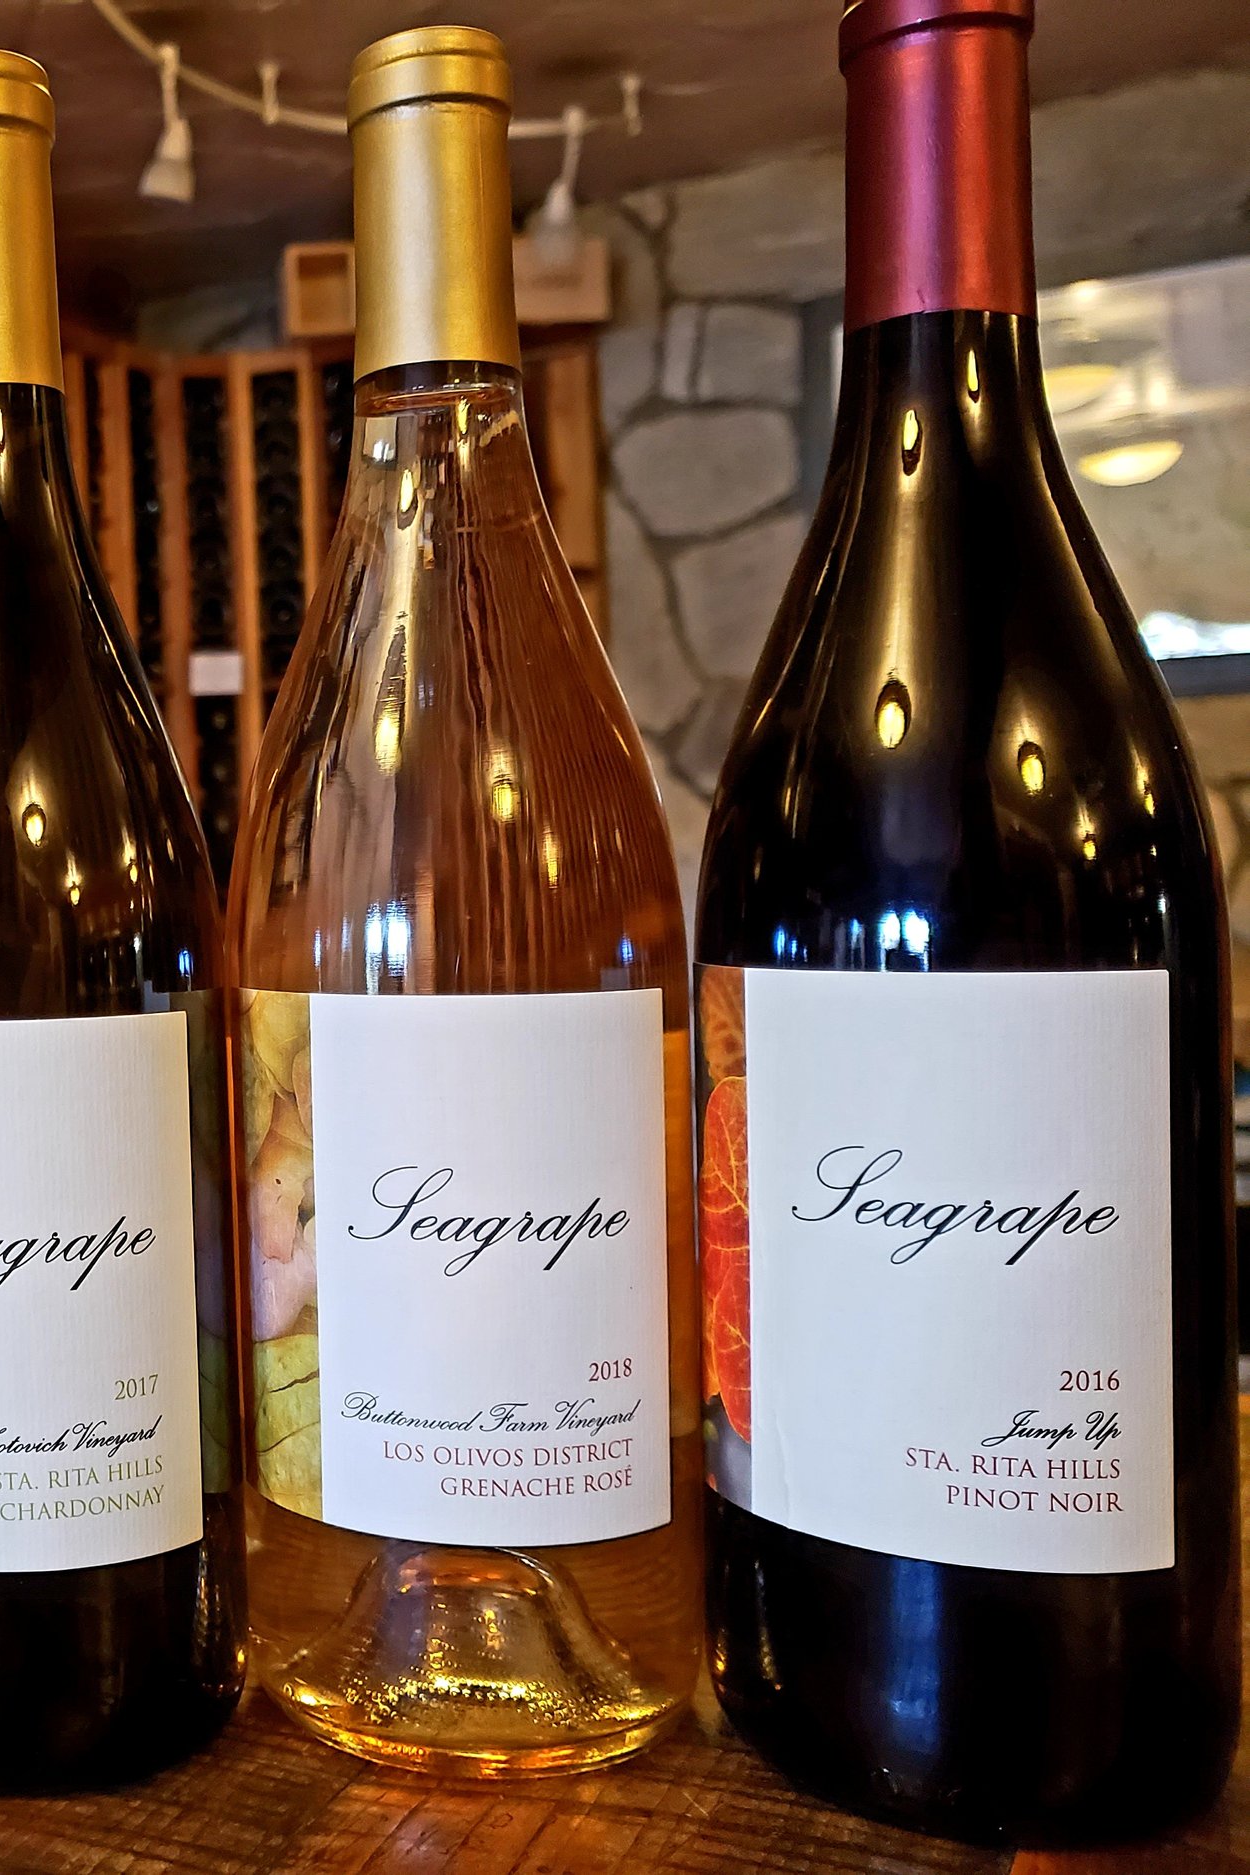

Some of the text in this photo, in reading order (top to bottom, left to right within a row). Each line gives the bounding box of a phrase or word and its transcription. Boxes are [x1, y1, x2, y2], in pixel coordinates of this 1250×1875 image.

[348, 1166, 630, 1277] Seagrape
[791, 1146, 1120, 1265] Seagrape
[589, 1358, 632, 1382] 2018
[1059, 1369, 1121, 1392] 2016
[114, 1374, 159, 1400] 2017
[341, 1391, 642, 1437] Buttonwood Farm Vineyard
[981, 1410, 1121, 1450] Jump Up
[72, 1414, 163, 1458] Vineyard
[383, 1438, 633, 1467] LOS OLIVOS DISTRICT
[48, 1467, 100, 1489] RITA
[108, 1455, 163, 1482] HILLS
[905, 1447, 1121, 1480] STA. RITA HILLS
[440, 1465, 633, 1497] GRENACHE ROSÉ
[0, 1485, 165, 1521] CHARDONNAY
[946, 1485, 1124, 1513] PINOT NOIR
